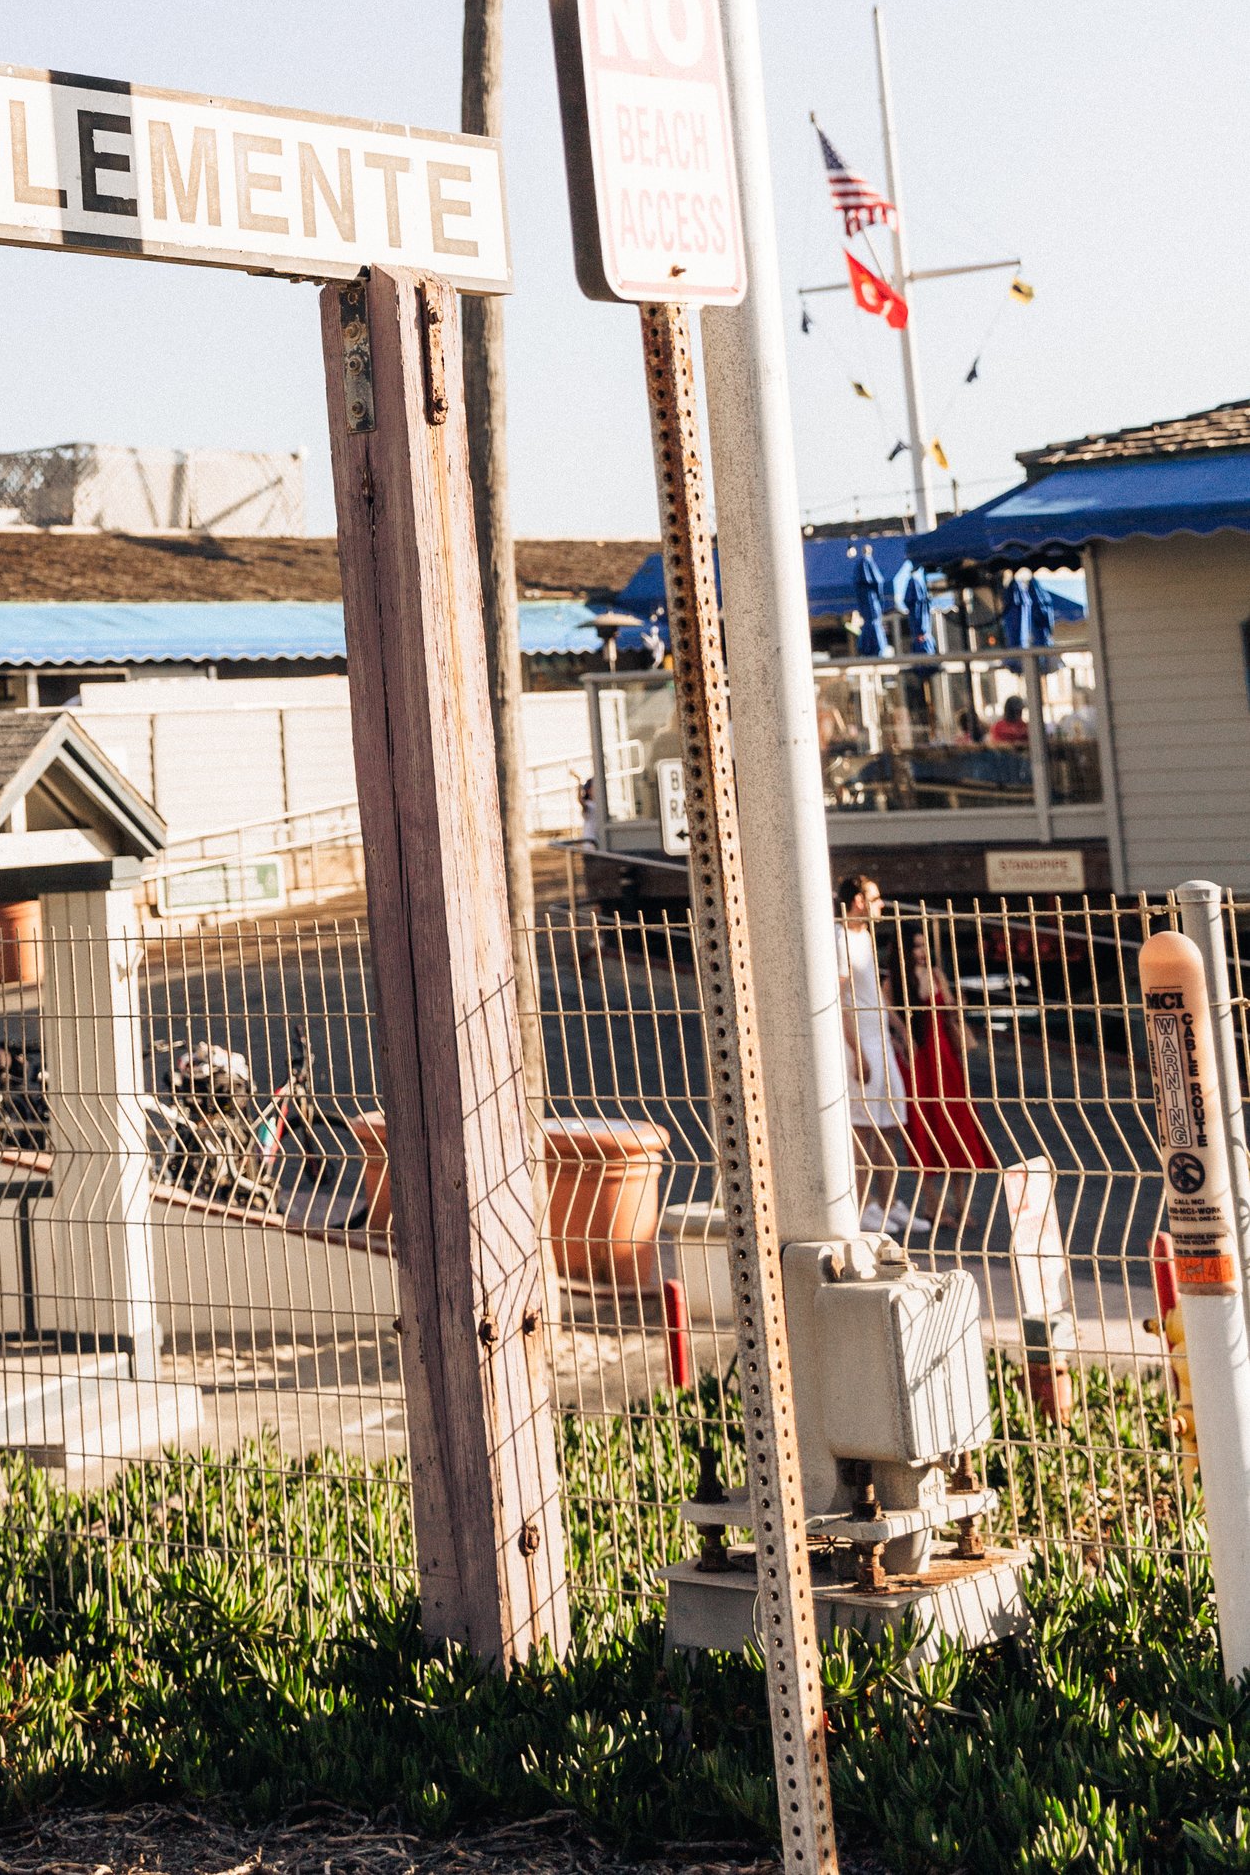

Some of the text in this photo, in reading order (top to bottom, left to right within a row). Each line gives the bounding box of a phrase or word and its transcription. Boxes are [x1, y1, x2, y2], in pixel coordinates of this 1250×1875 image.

[616, 104, 710, 171] BEACH
[620, 188, 727, 255] ACCESS
[1145, 992, 1184, 1010] MCI
[1156, 1017, 1188, 1145] WARNING
[1181, 1012, 1208, 1147] CABLE ROUTE
